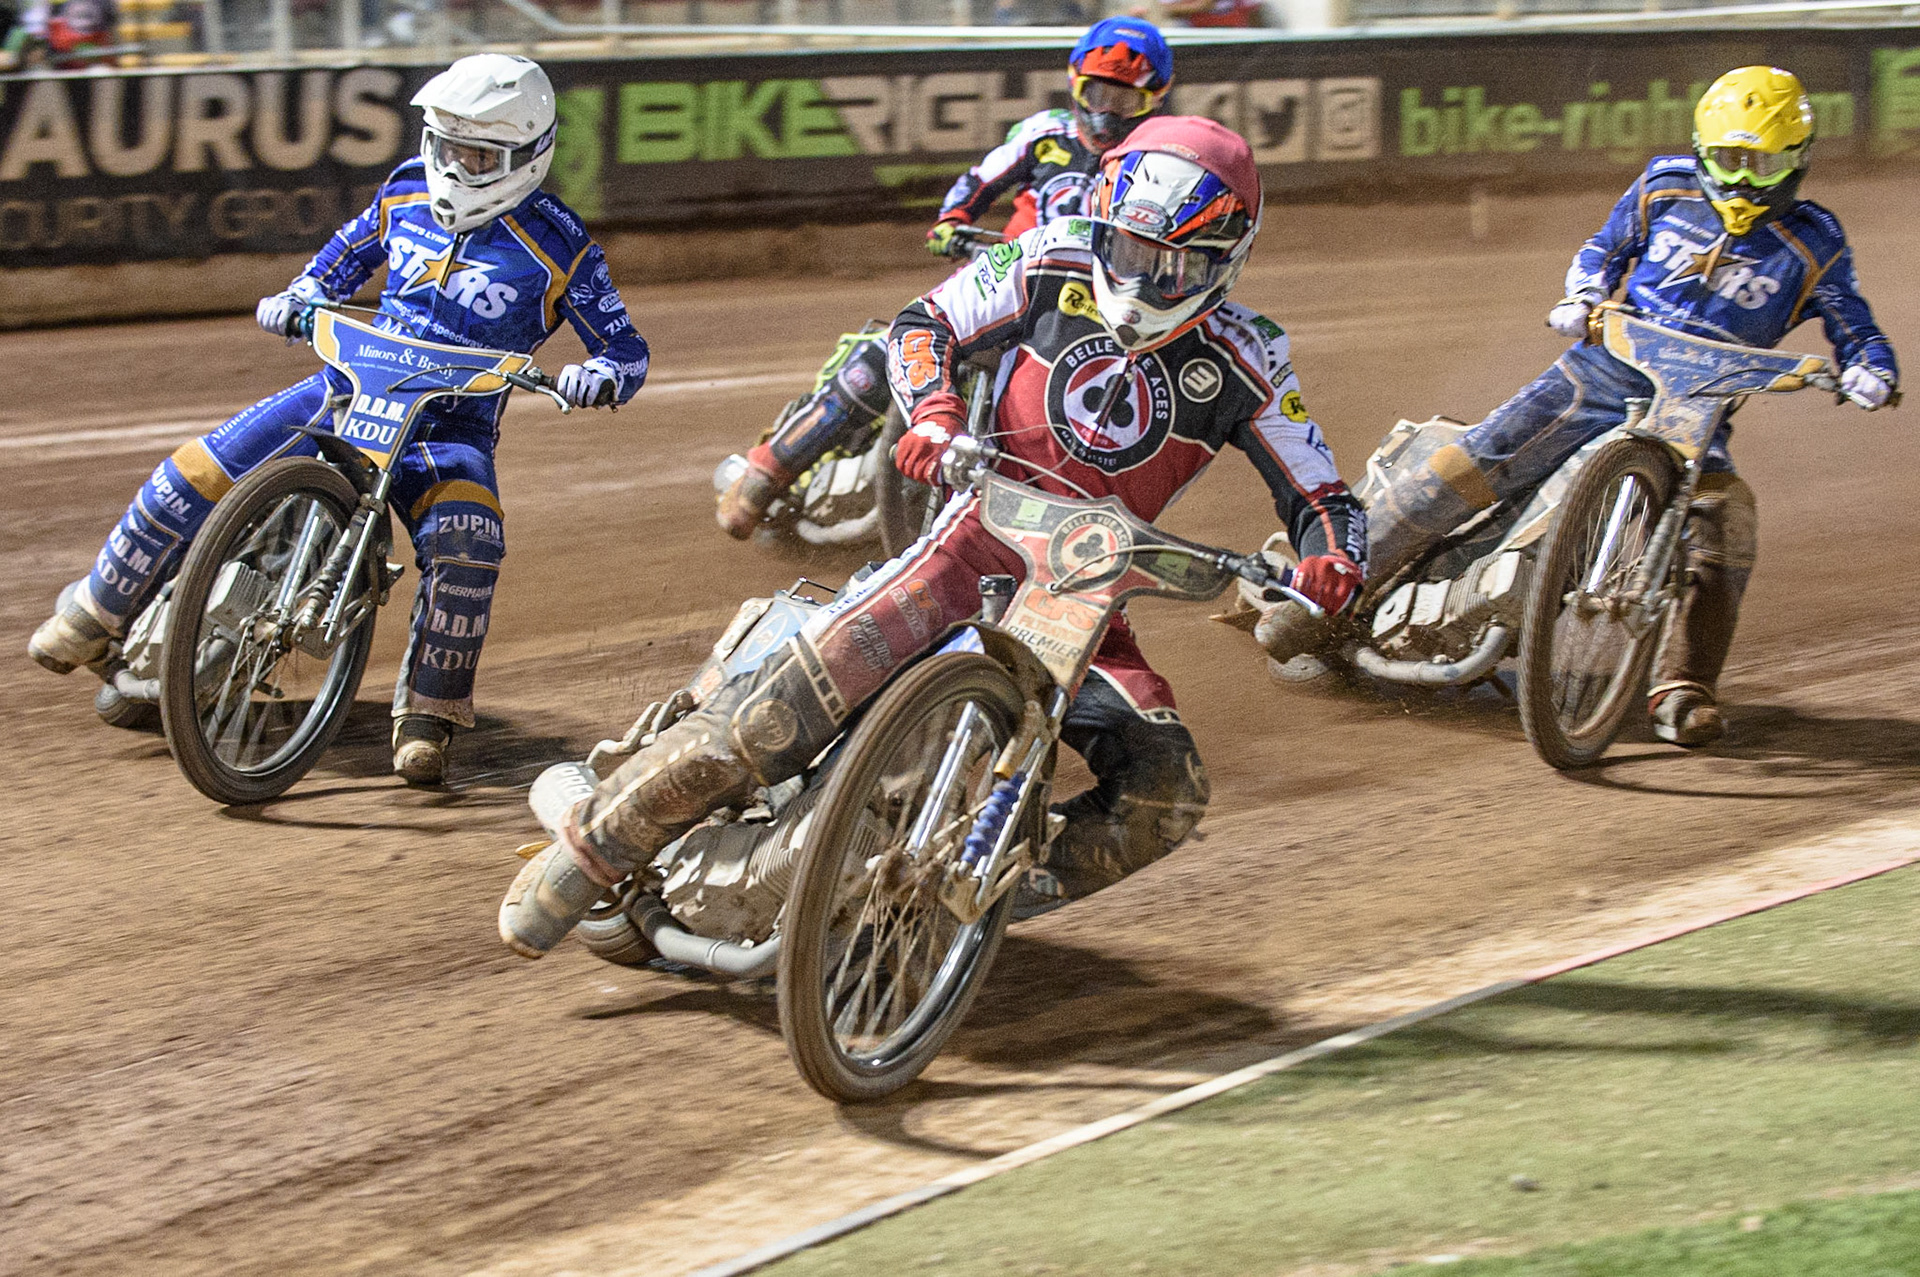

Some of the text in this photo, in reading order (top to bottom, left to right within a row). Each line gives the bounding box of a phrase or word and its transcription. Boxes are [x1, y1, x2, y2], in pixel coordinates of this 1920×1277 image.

[388, 235, 519, 320] STARS
[355, 343, 399, 362] Minors
[398, 347, 418, 367] &
[1064, 339, 1115, 369] BELLE
[1149, 375, 1169, 421] ACES
[343, 417, 399, 446] KDU
[438, 513, 501, 540] ZUPIN
[421, 643, 480, 670] KDU
